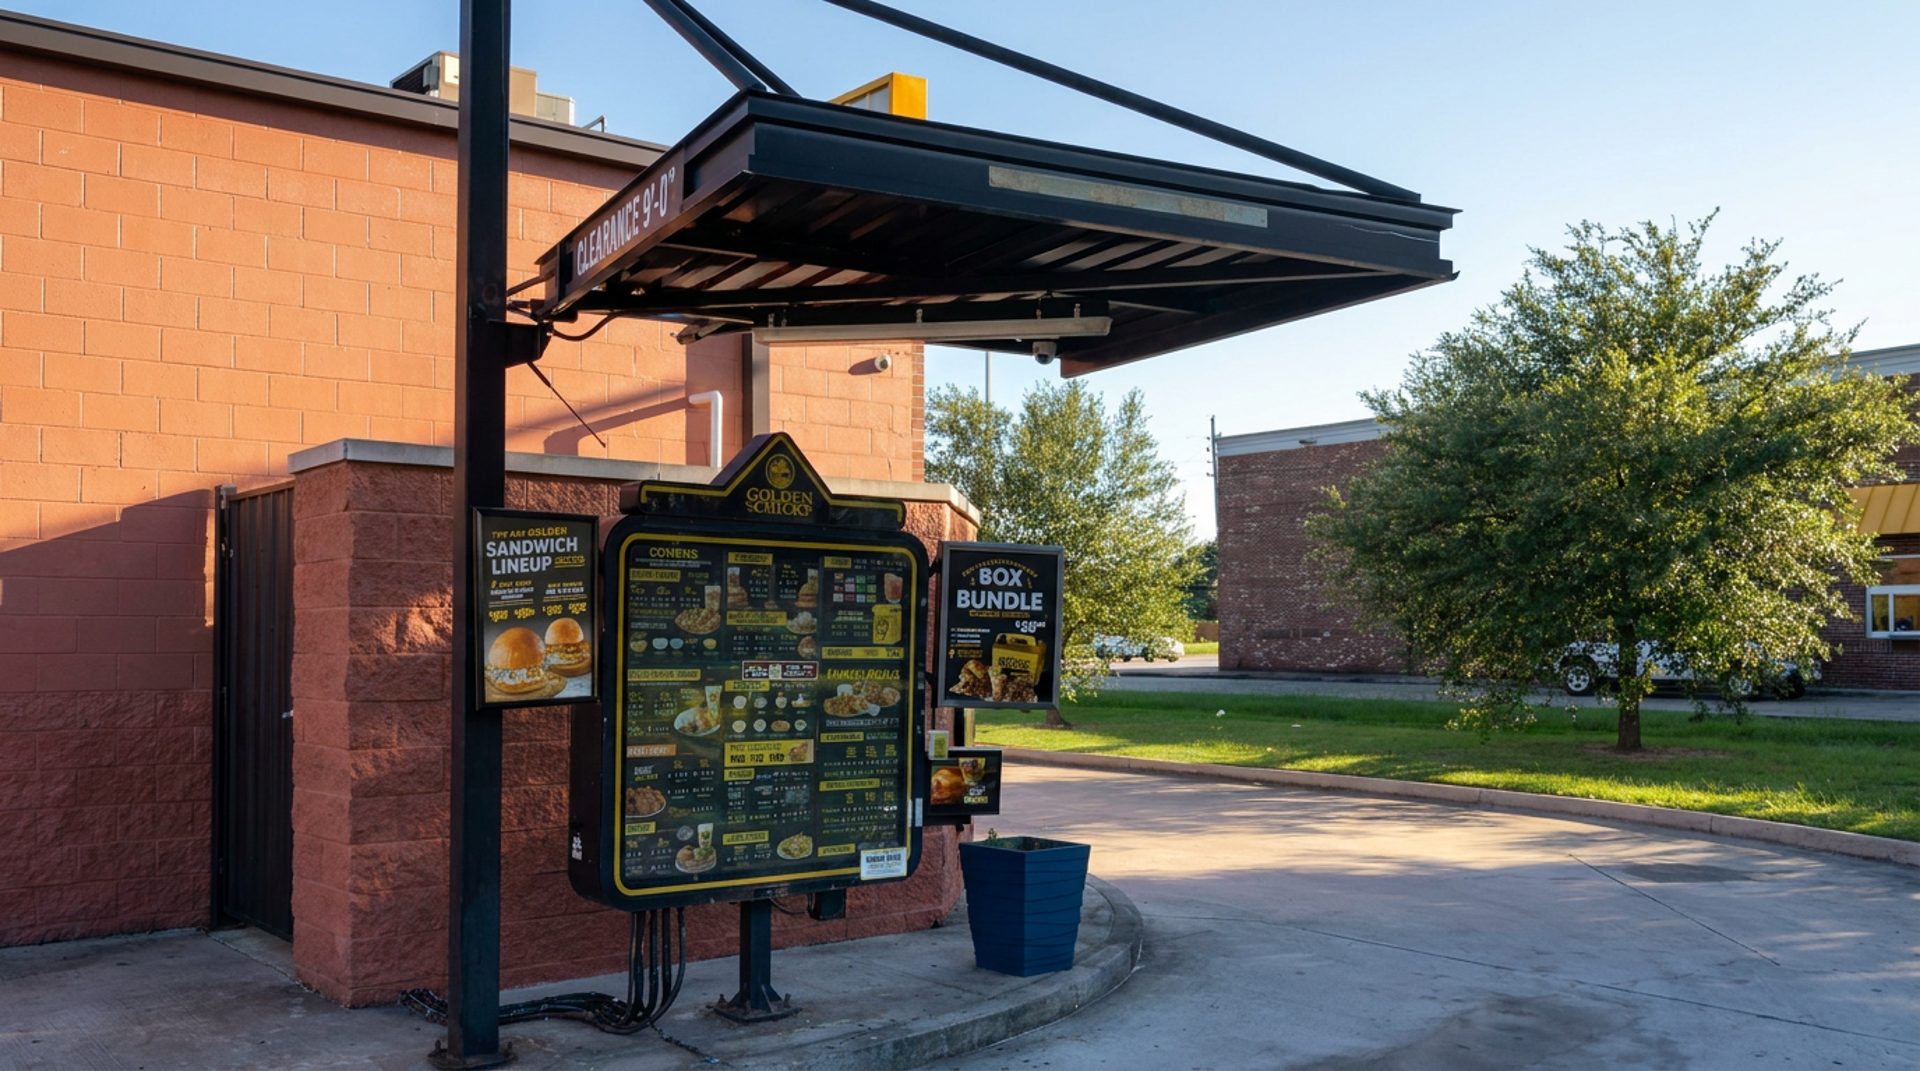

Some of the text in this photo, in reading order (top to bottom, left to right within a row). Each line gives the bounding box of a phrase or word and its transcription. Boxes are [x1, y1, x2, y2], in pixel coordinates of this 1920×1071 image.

[577, 194, 640, 275] CLEARANCE
[746, 487, 813, 505] GOLDEN
[486, 537, 578, 557] SANDWICH
[491, 556, 552, 575] LINEUP
[979, 567, 1023, 587] BOX
[956, 589, 1044, 611] BUNDLE
